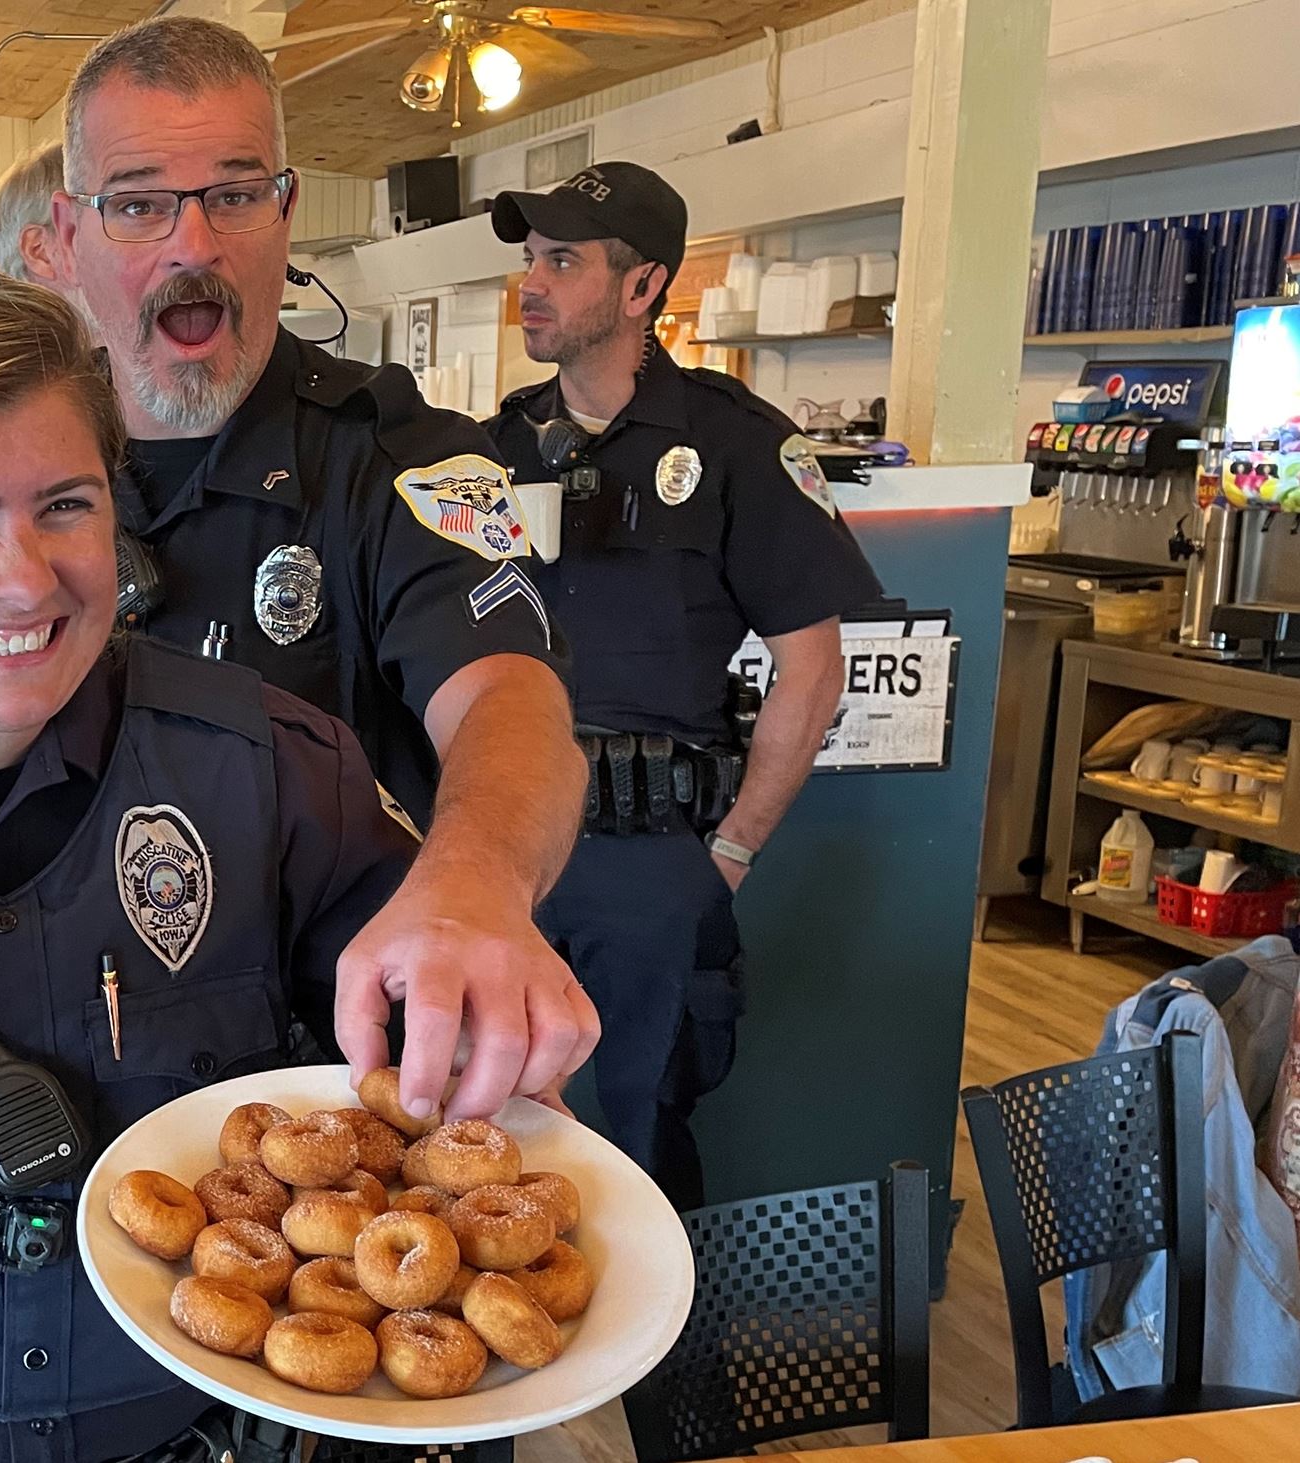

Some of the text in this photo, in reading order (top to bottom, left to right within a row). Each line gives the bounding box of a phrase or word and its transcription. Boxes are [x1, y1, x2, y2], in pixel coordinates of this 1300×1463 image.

[1125, 378, 1192, 411] pepsi
[450, 483, 493, 496] POLICE
[136, 842, 189, 870] MUSCATINE
[151, 907, 189, 925] POLICE
[159, 927, 186, 942] IOWA
[10, 1151, 56, 1176] MOTOROLA
